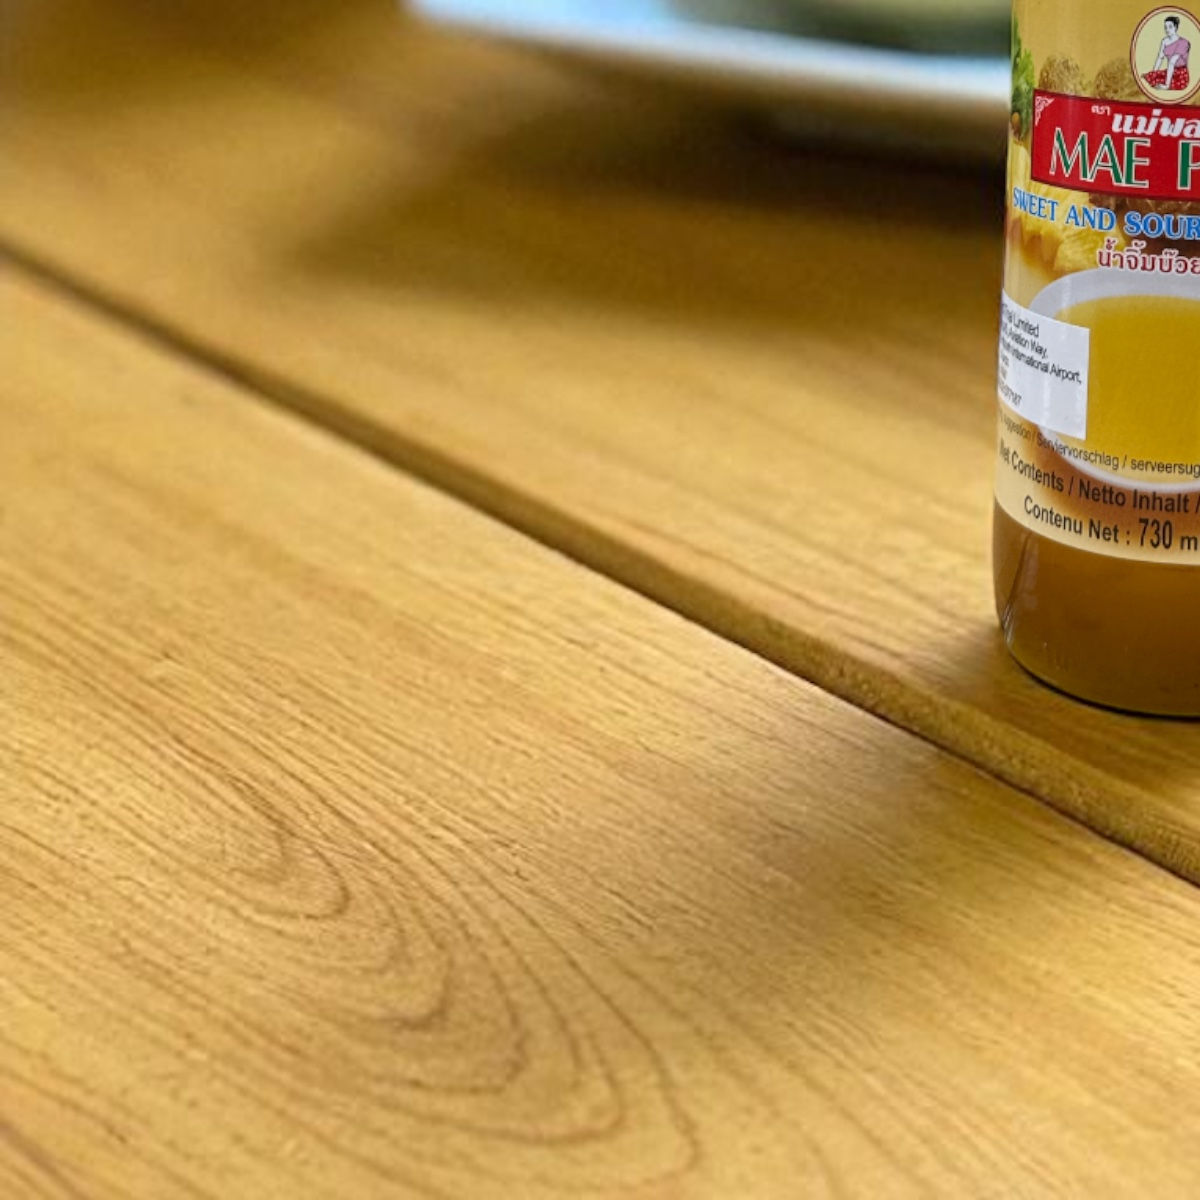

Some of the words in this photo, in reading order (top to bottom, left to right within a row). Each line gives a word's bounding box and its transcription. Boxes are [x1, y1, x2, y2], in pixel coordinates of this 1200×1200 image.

[1049, 127, 1152, 188] MAE
[1012, 186, 1060, 221] SWEET
[1065, 206, 1116, 231] AND
[1049, 363, 1082, 385] Airport,
[1011, 450, 1065, 493] Contents
[1068, 477, 1075, 496] /
[1079, 481, 1127, 507] Netto
[1132, 489, 1190, 513] Inhalt
[1024, 495, 1083, 535] Contenu
[1088, 519, 1120, 543] Net
[1138, 518, 1173, 549] 730
